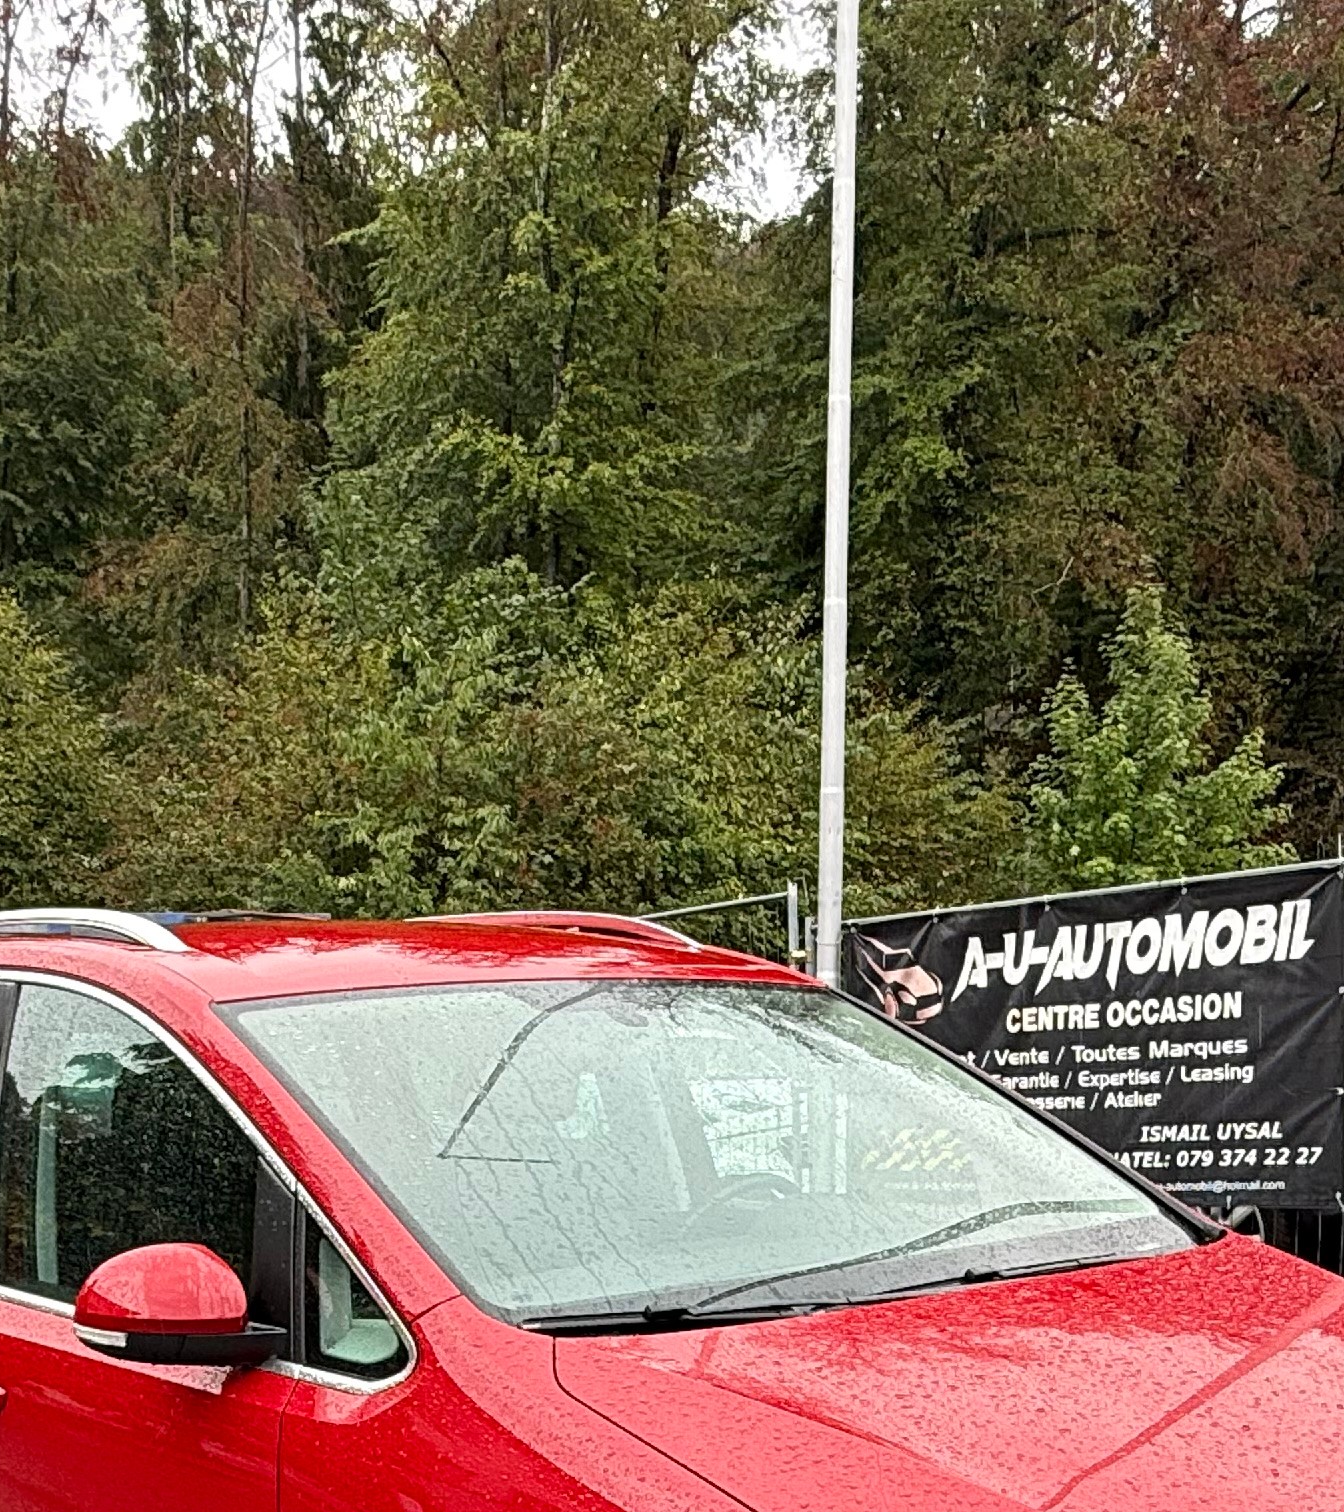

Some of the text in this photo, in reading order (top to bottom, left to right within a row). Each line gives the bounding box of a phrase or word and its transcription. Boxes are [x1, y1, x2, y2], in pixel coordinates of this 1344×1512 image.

[1006, 991, 1243, 1034] CENTRE OCCASION
[993, 1048, 1050, 1066] Vente
[1071, 1043, 1141, 1063] Toutes
[1148, 1038, 1248, 1060] Marques
[1078, 1068, 1161, 1091] Expertise
[1180, 1062, 1255, 1084] Leasing
[1104, 1090, 1162, 1109] Atelier
[1139, 1121, 1284, 1143] ISMAIL UYSAL
[1176, 1149, 1215, 1168] 079
[1218, 1148, 1257, 1167] 374
[1262, 1147, 1290, 1166] 22
[1294, 1146, 1324, 1165] 27
